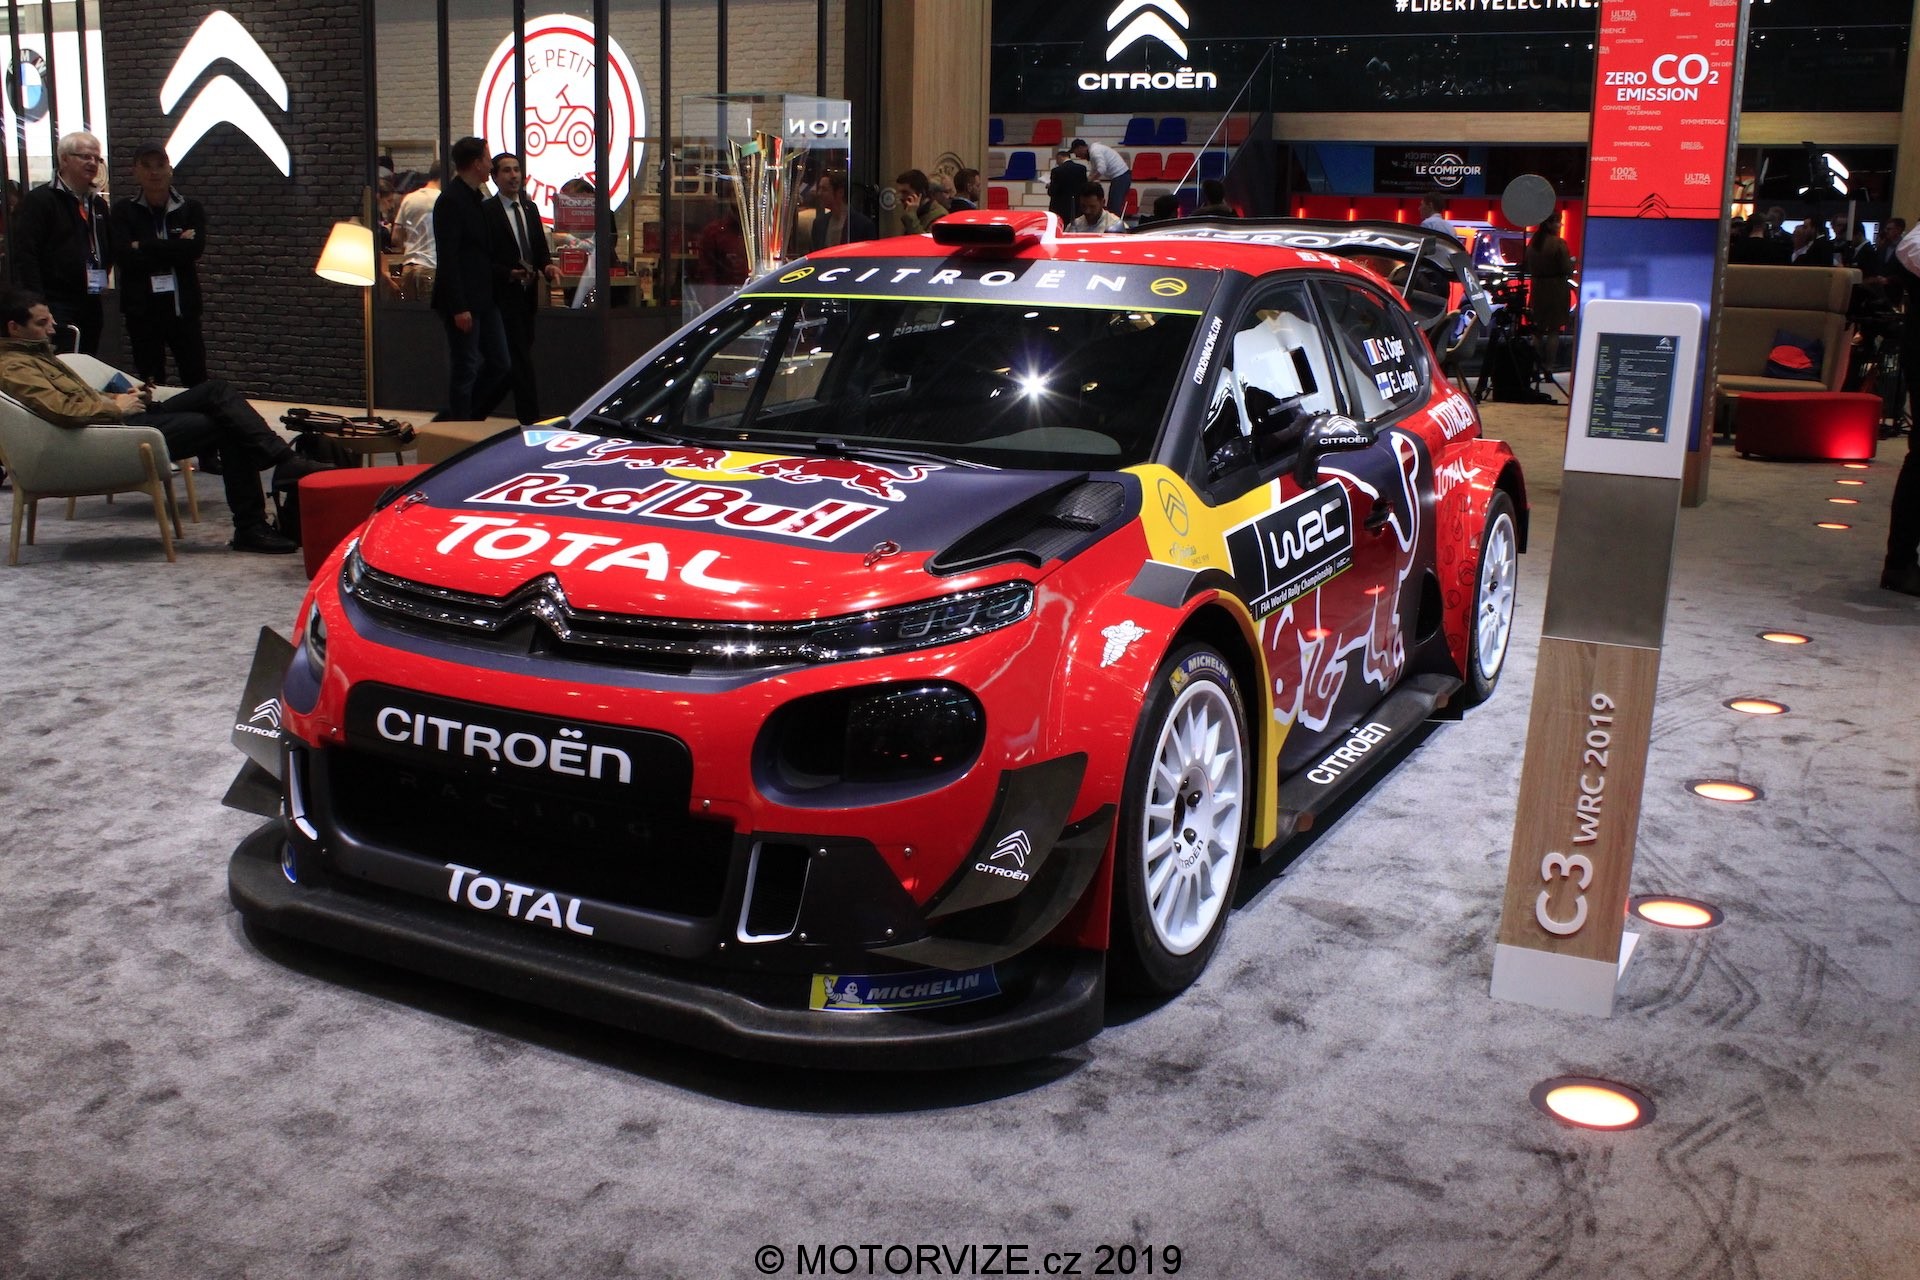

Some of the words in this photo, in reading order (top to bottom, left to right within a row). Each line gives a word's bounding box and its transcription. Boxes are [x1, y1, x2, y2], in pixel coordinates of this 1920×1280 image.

[545, 48, 595, 78] PETIT
[1605, 72, 1647, 85] ZERO
[1617, 88, 1698, 101] EMISSION
[1416, 166, 1426, 175] LE
[1428, 166, 1481, 175] COMPTOIR
[817, 267, 1128, 291] CITROËN
[1384, 336, 1405, 363] Ogier
[1396, 365, 1418, 393] Lappi
[1435, 456, 1482, 501] TOTAL
[465, 473, 689, 514] Red
[640, 484, 888, 542] Bull
[1269, 498, 1345, 569] WRC
[436, 516, 742, 593] TOTAL
[1261, 600, 1271, 614] FIA
[1271, 588, 1287, 608] World
[1288, 583, 1300, 598] Rally
[1301, 564, 1333, 590] Championship
[1188, 655, 1229, 678] MICHELIN
[1584, 693, 1616, 768] 2019
[1573, 775, 1605, 843] WRC
[445, 863, 594, 936] TOTAL
[1536, 852, 1593, 935] C3
[867, 973, 980, 1000] MICHELIN
